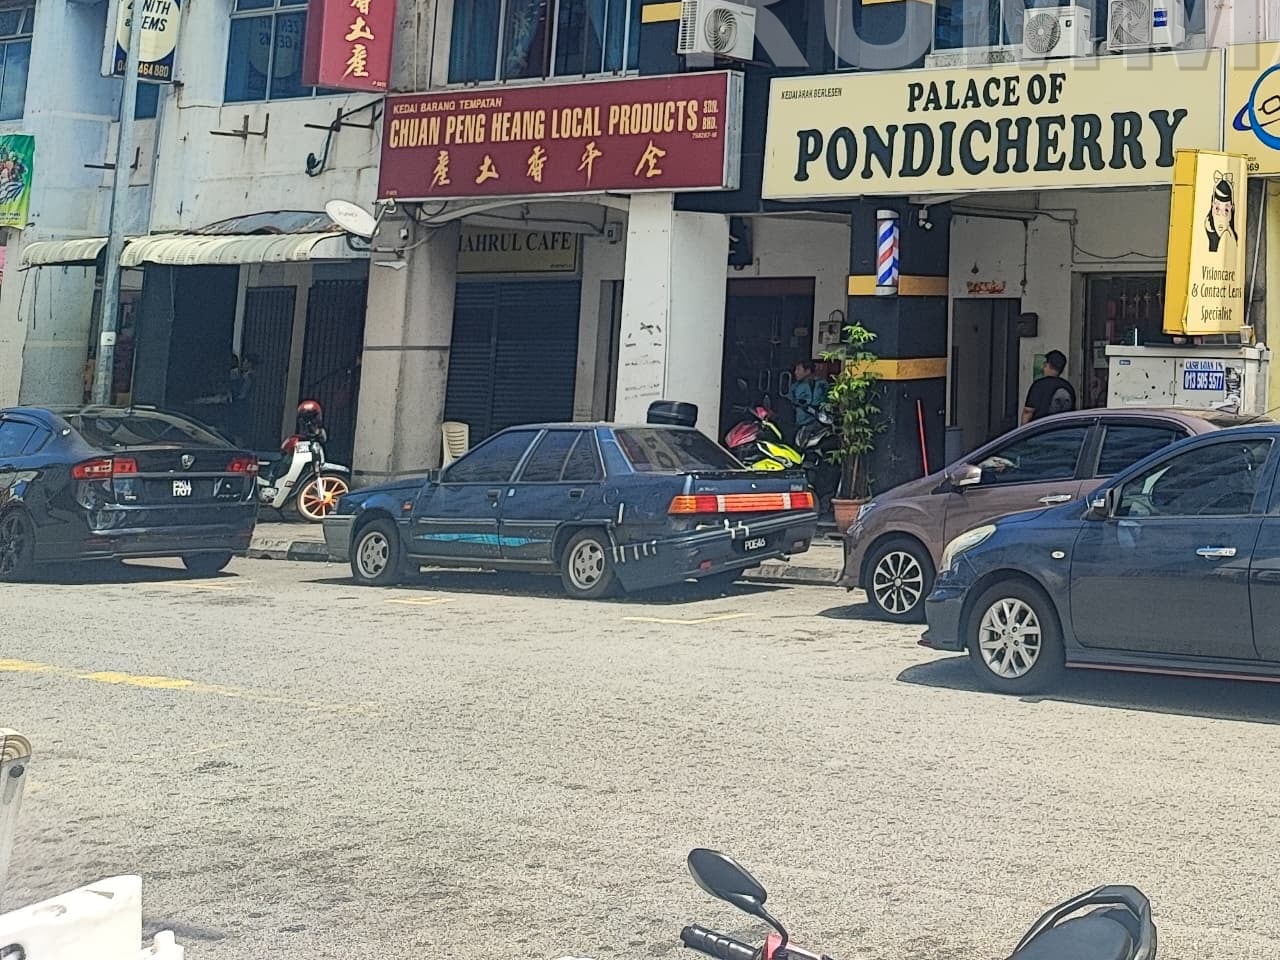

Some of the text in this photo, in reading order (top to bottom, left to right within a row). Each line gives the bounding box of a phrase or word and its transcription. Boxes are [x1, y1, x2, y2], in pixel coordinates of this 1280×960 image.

[781, 90, 797, 100] KEDAI
[814, 87, 842, 98] BERLESEN
[907, 73, 1066, 112] PALACE OF
[393, 97, 502, 114] KEDAI BARANG TEMPATAN
[389, 100, 719, 149] CHUAN PENG HEANG LOCAL PRODUCTS SDN.
[702, 116, 718, 131] BHD.
[794, 108, 1188, 182] PONDICHERRY
[526, 231, 572, 252] CAFE
[1201, 265, 1236, 282] Visioncare
[1191, 283, 1242, 299] & Contact Lens
[1200, 305, 1232, 322] Specialist
[1184, 371, 1196, 389] 013
[1196, 371, 1208, 389] 505
